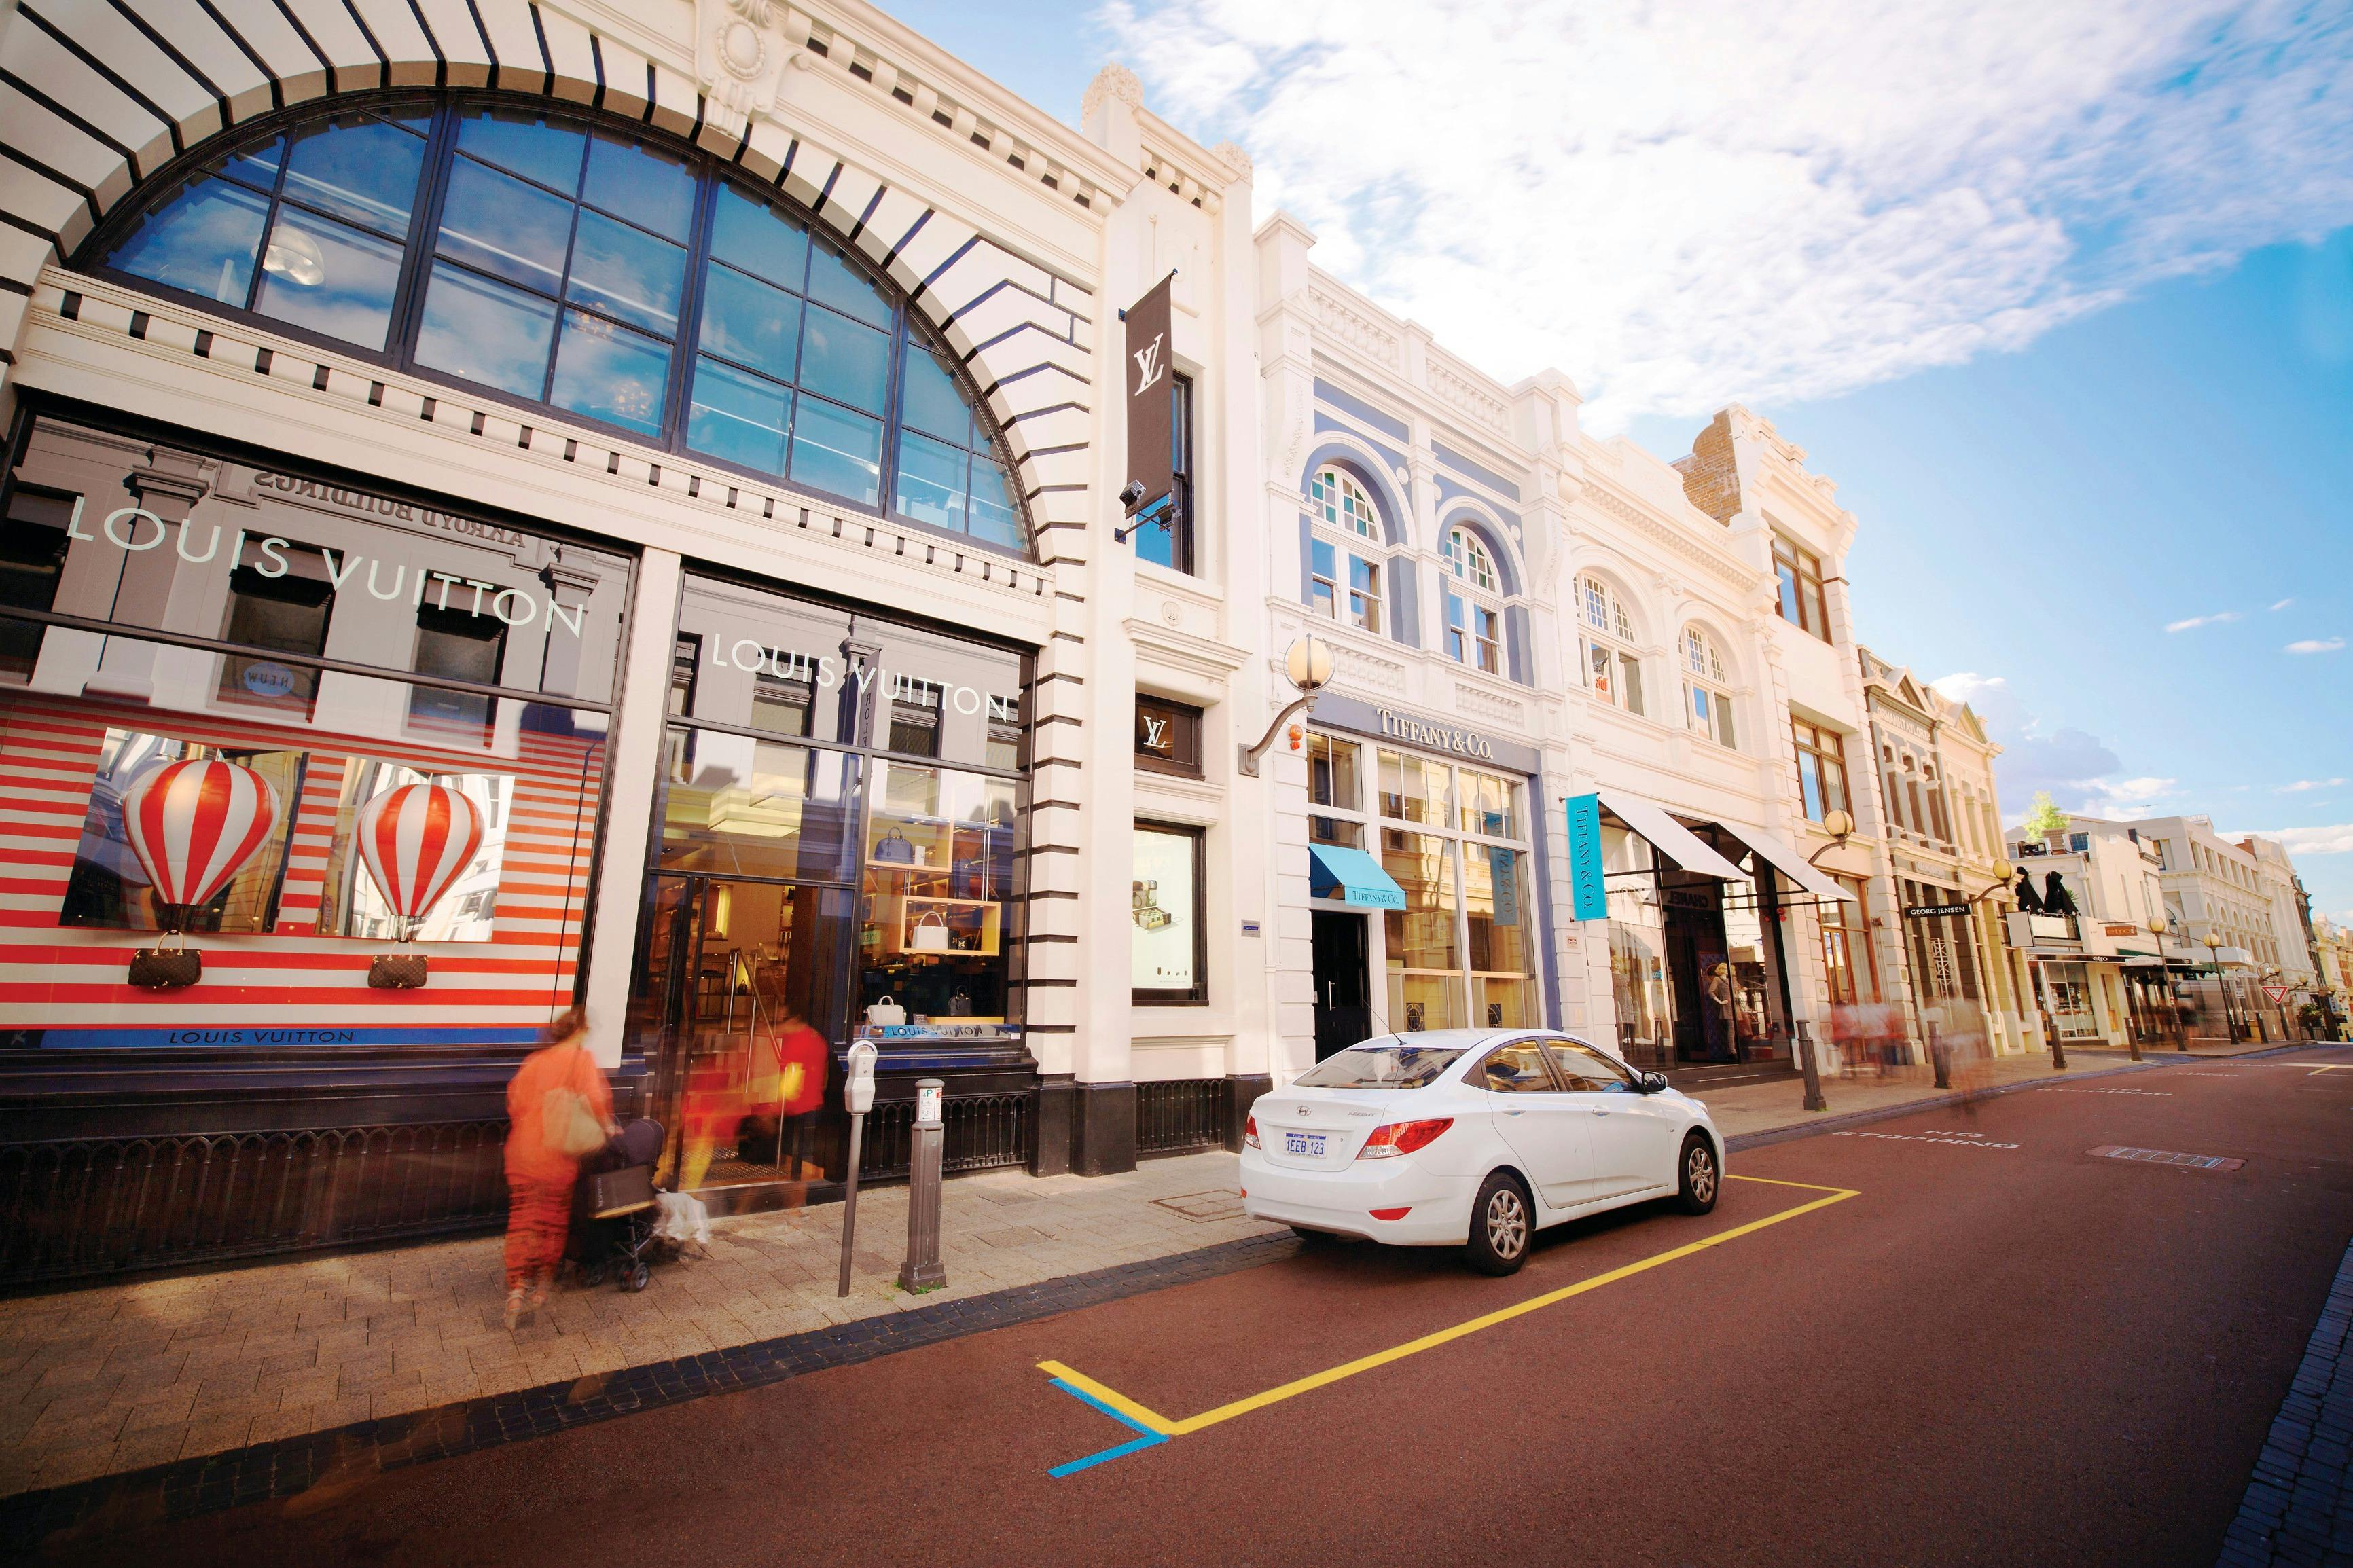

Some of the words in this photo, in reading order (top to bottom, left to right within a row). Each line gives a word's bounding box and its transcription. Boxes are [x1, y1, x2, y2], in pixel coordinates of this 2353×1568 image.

[67, 496, 291, 578] LOUIS
[322, 549, 584, 638] VUITTON
[713, 633, 836, 687] LOUIS
[852, 663, 1009, 723] VUITTON
[1937, 907, 1965, 915] JENSEN
[170, 1032, 243, 1044] LOUIS
[254, 1031, 355, 1043] VUITTON
[891, 1027, 928, 1036] LOUIS
[935, 1027, 983, 1036] VUITTON
[1832, 1131, 2022, 1149] STOPPING
